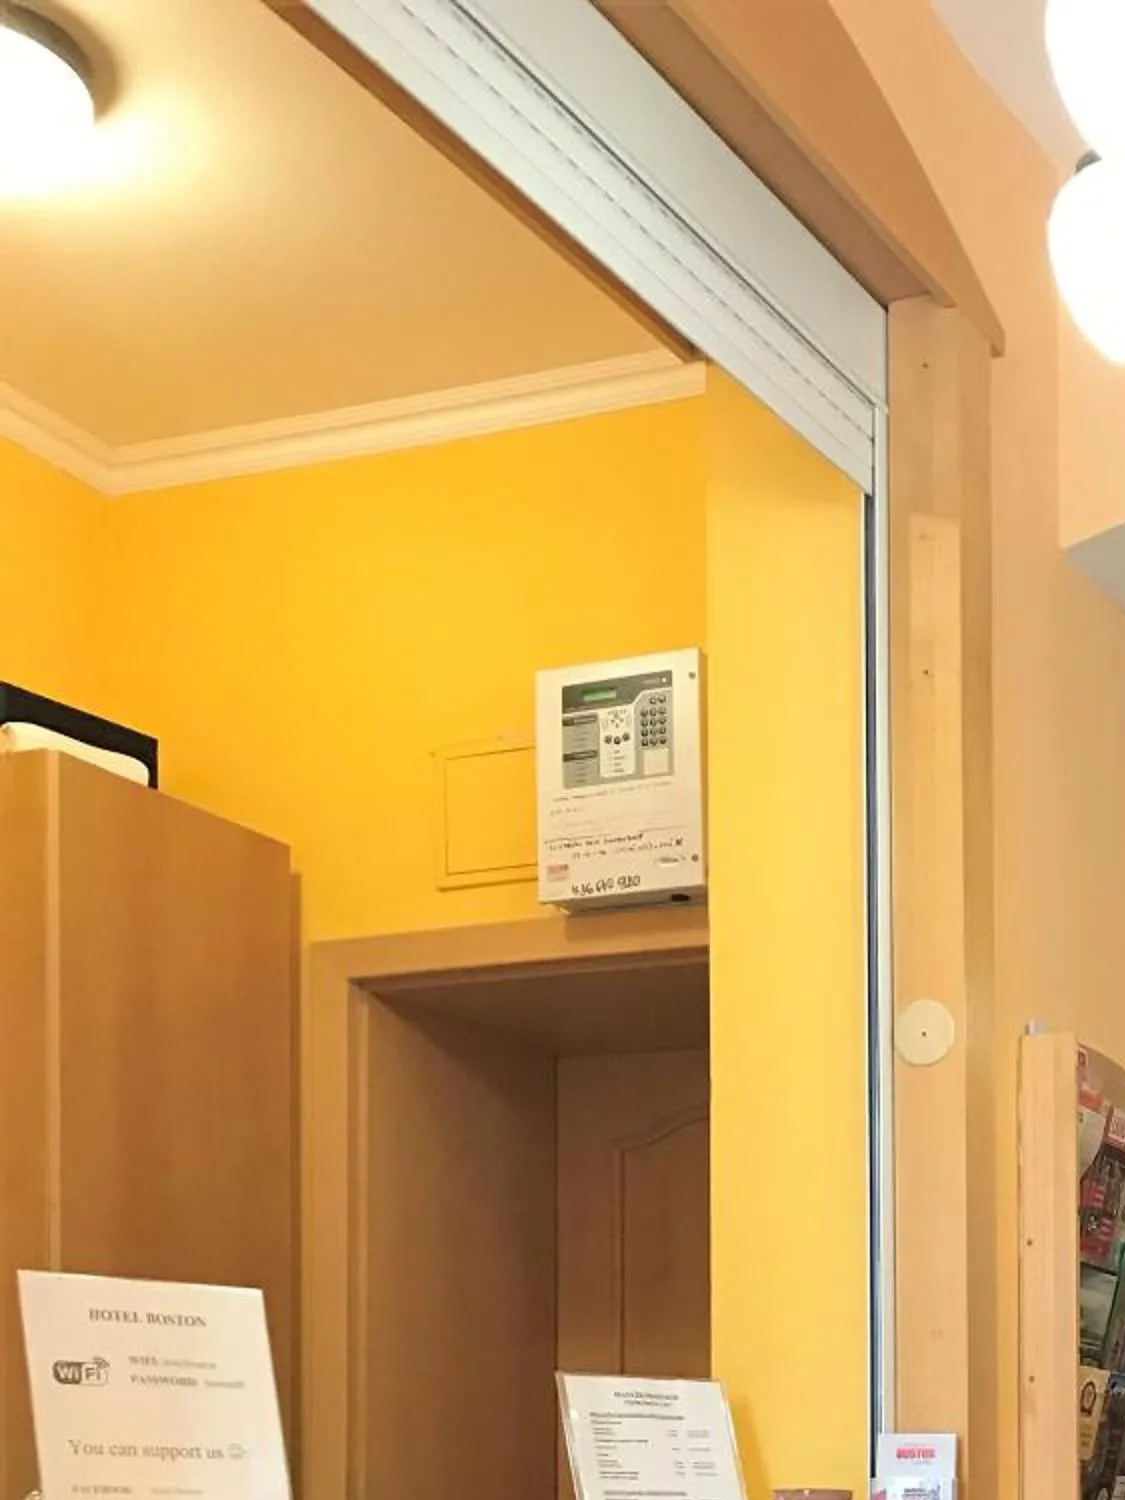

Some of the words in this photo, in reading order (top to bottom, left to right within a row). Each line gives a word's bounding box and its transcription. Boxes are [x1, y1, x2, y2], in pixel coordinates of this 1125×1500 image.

[88, 1308, 142, 1325] HOTEL
[147, 1313, 207, 1328] BOSTON
[69, 1439, 103, 1456] You
[109, 1444, 137, 1457] can
[142, 1443, 201, 1462] support
[206, 1448, 224, 1460] us
